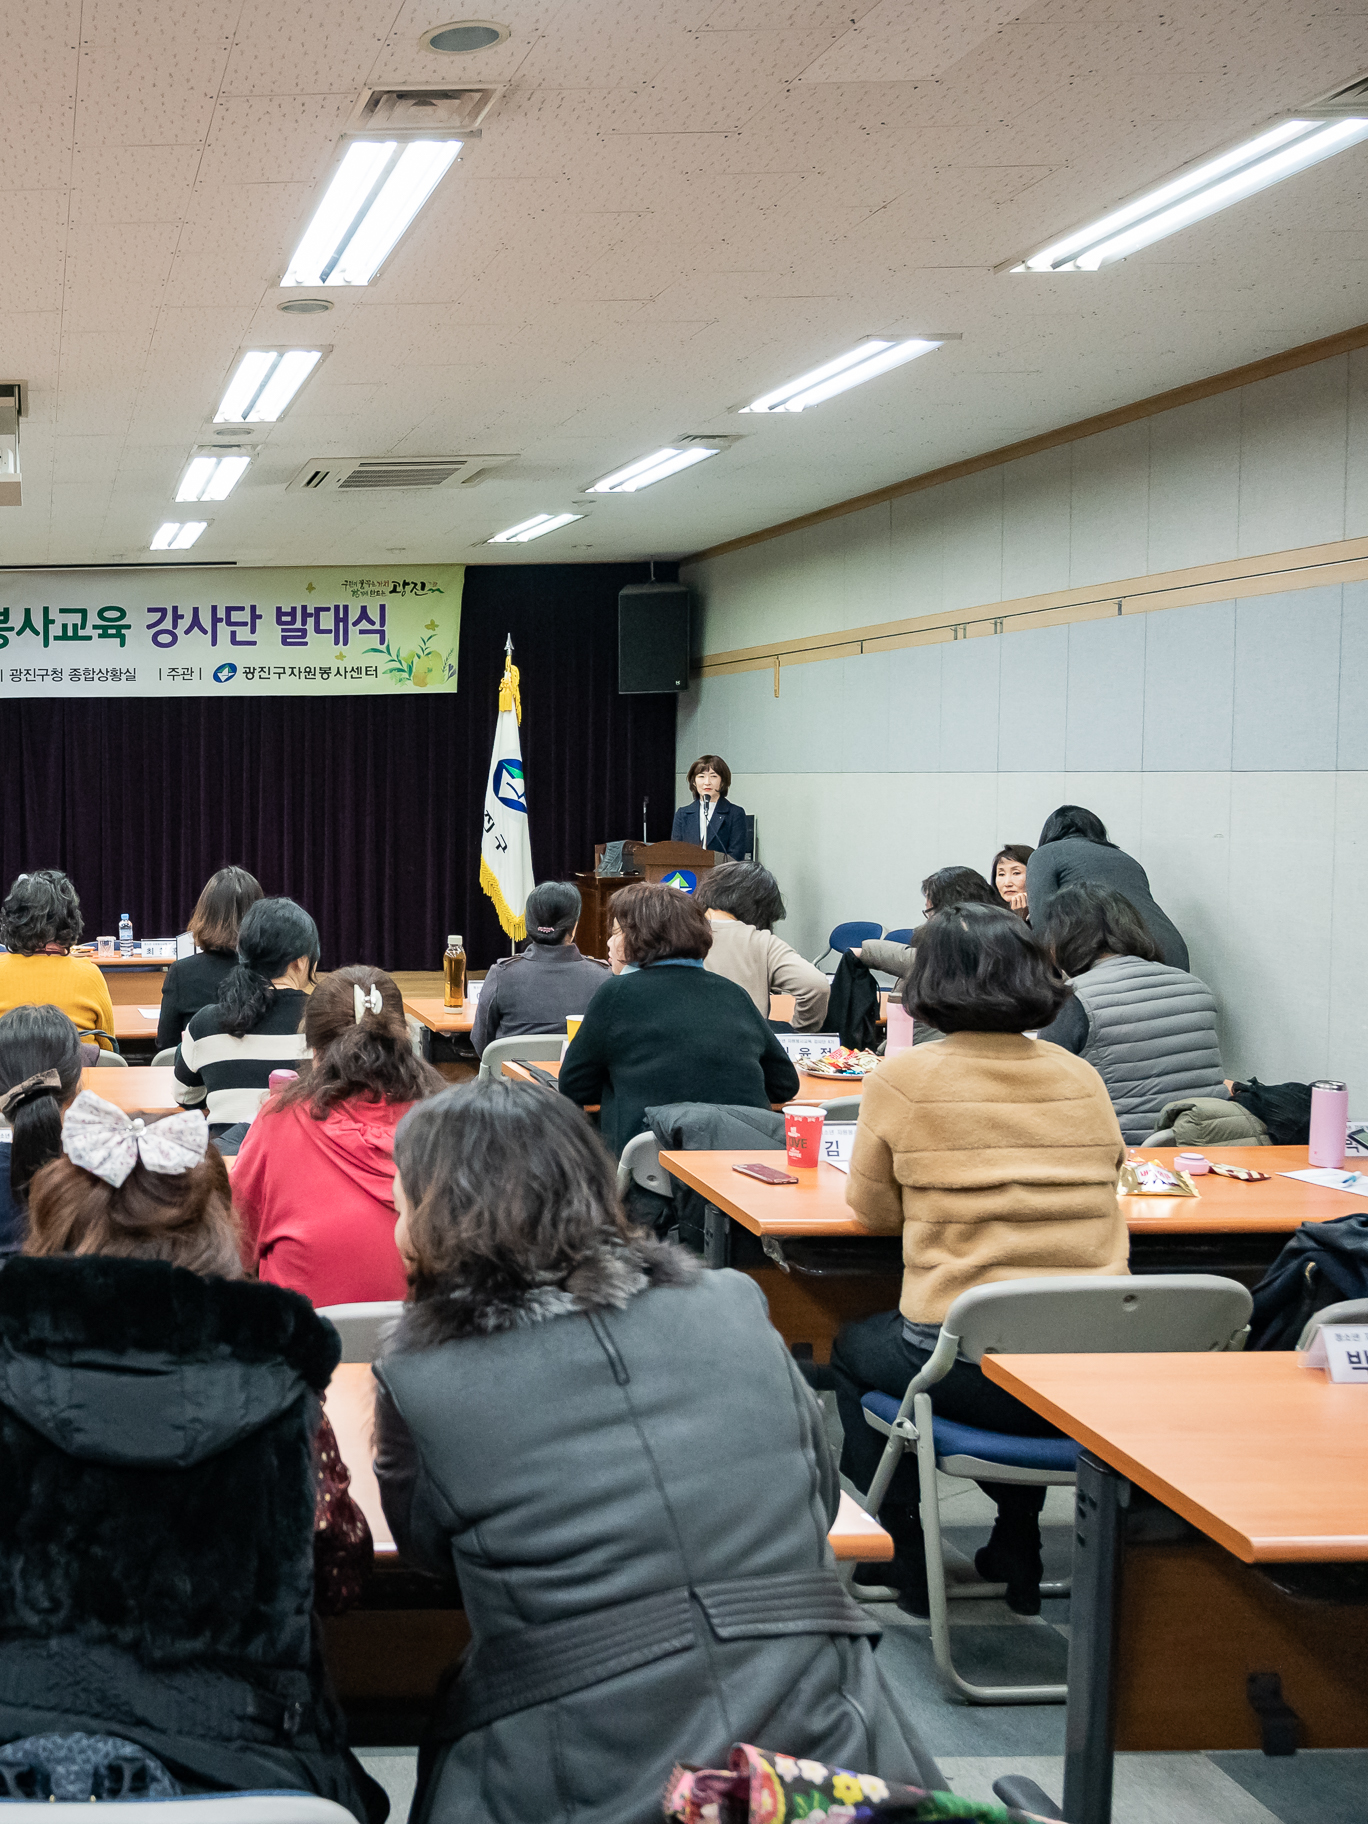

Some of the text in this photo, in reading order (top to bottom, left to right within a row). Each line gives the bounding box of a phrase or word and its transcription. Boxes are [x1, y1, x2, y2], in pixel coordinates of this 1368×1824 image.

[145, 604, 263, 649] 강사단
[275, 603, 388, 647] 발대식
[9, 668, 63, 683] 광진구청
[68, 667, 137, 682] 종합상황실
[242, 664, 379, 681] 광진구자원봉사센터
